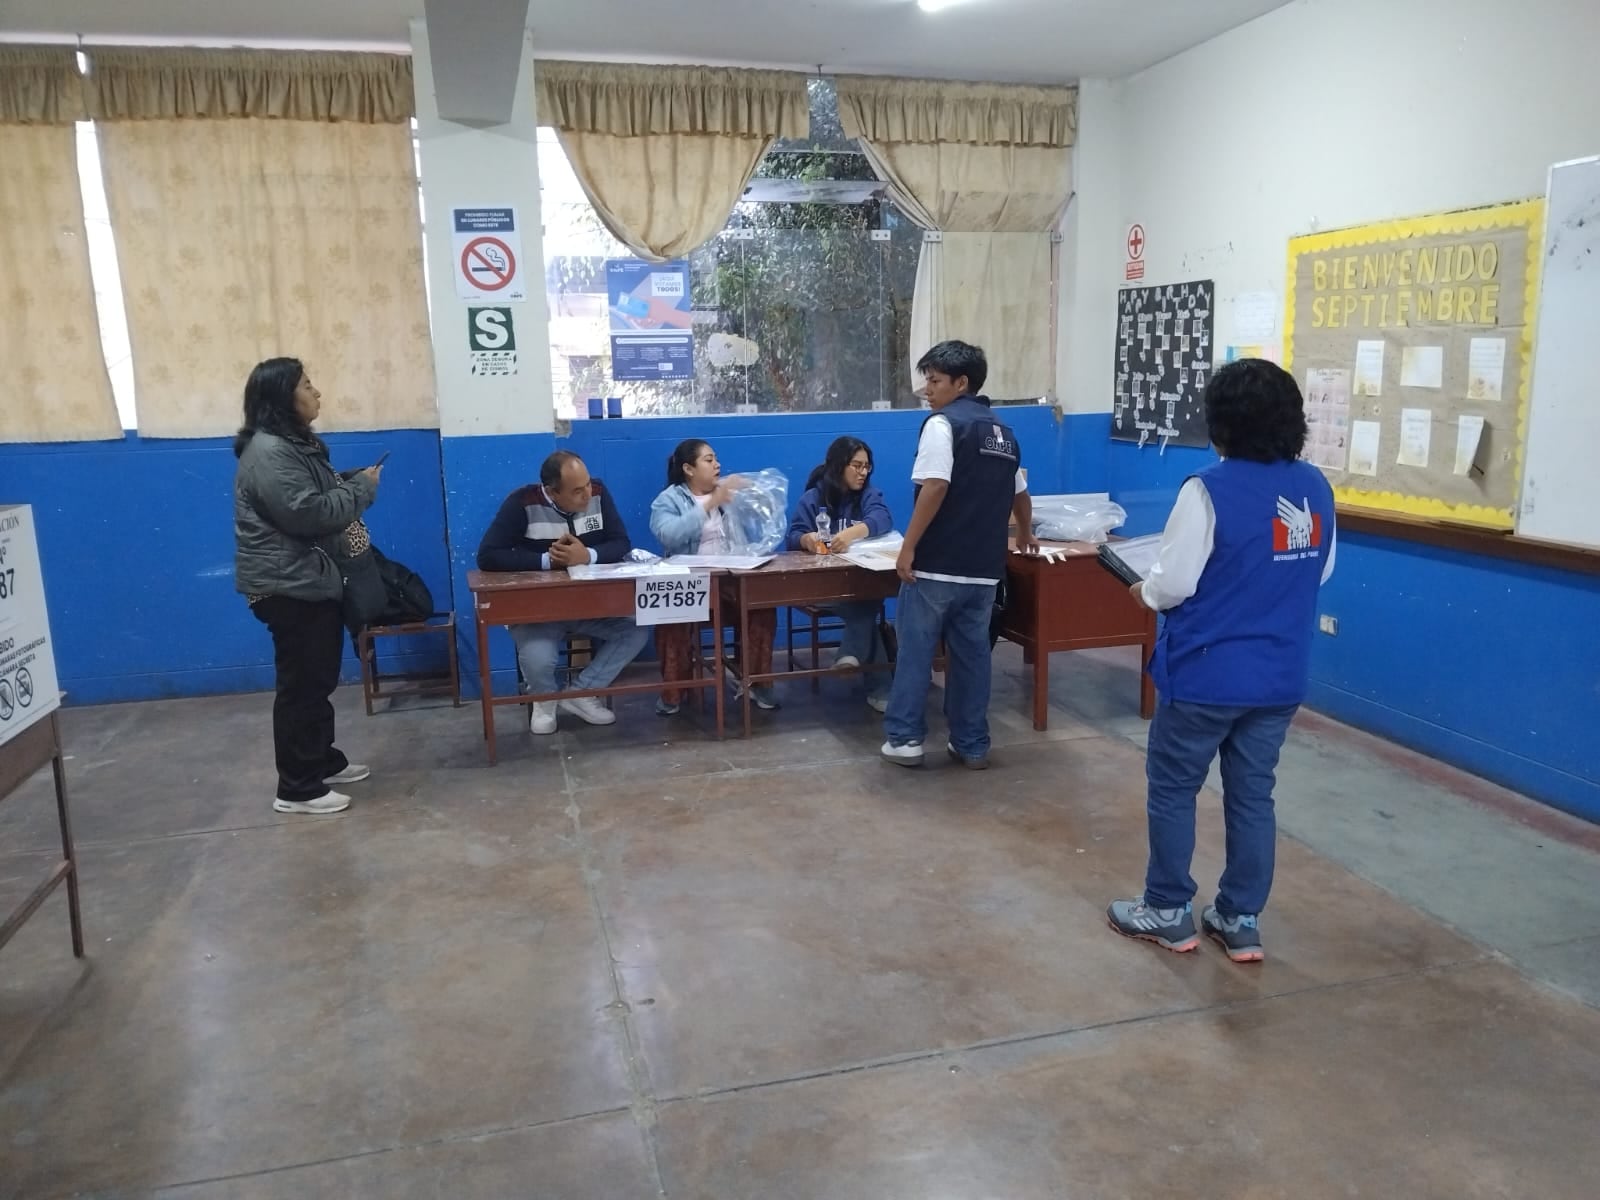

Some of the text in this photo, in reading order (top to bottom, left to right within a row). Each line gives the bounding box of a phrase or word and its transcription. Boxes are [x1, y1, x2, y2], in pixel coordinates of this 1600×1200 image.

[1311, 240, 1500, 291] BIENVENIDO
[1119, 283, 1211, 313] HAPPY BIRTHDAY
[1311, 283, 1500, 328] SEPTIEMBRE
[475, 309, 509, 348] S
[0, 513, 19, 532] CIÓN
[637, 591, 708, 609] 021587
[645, 581, 684, 592] MESA
